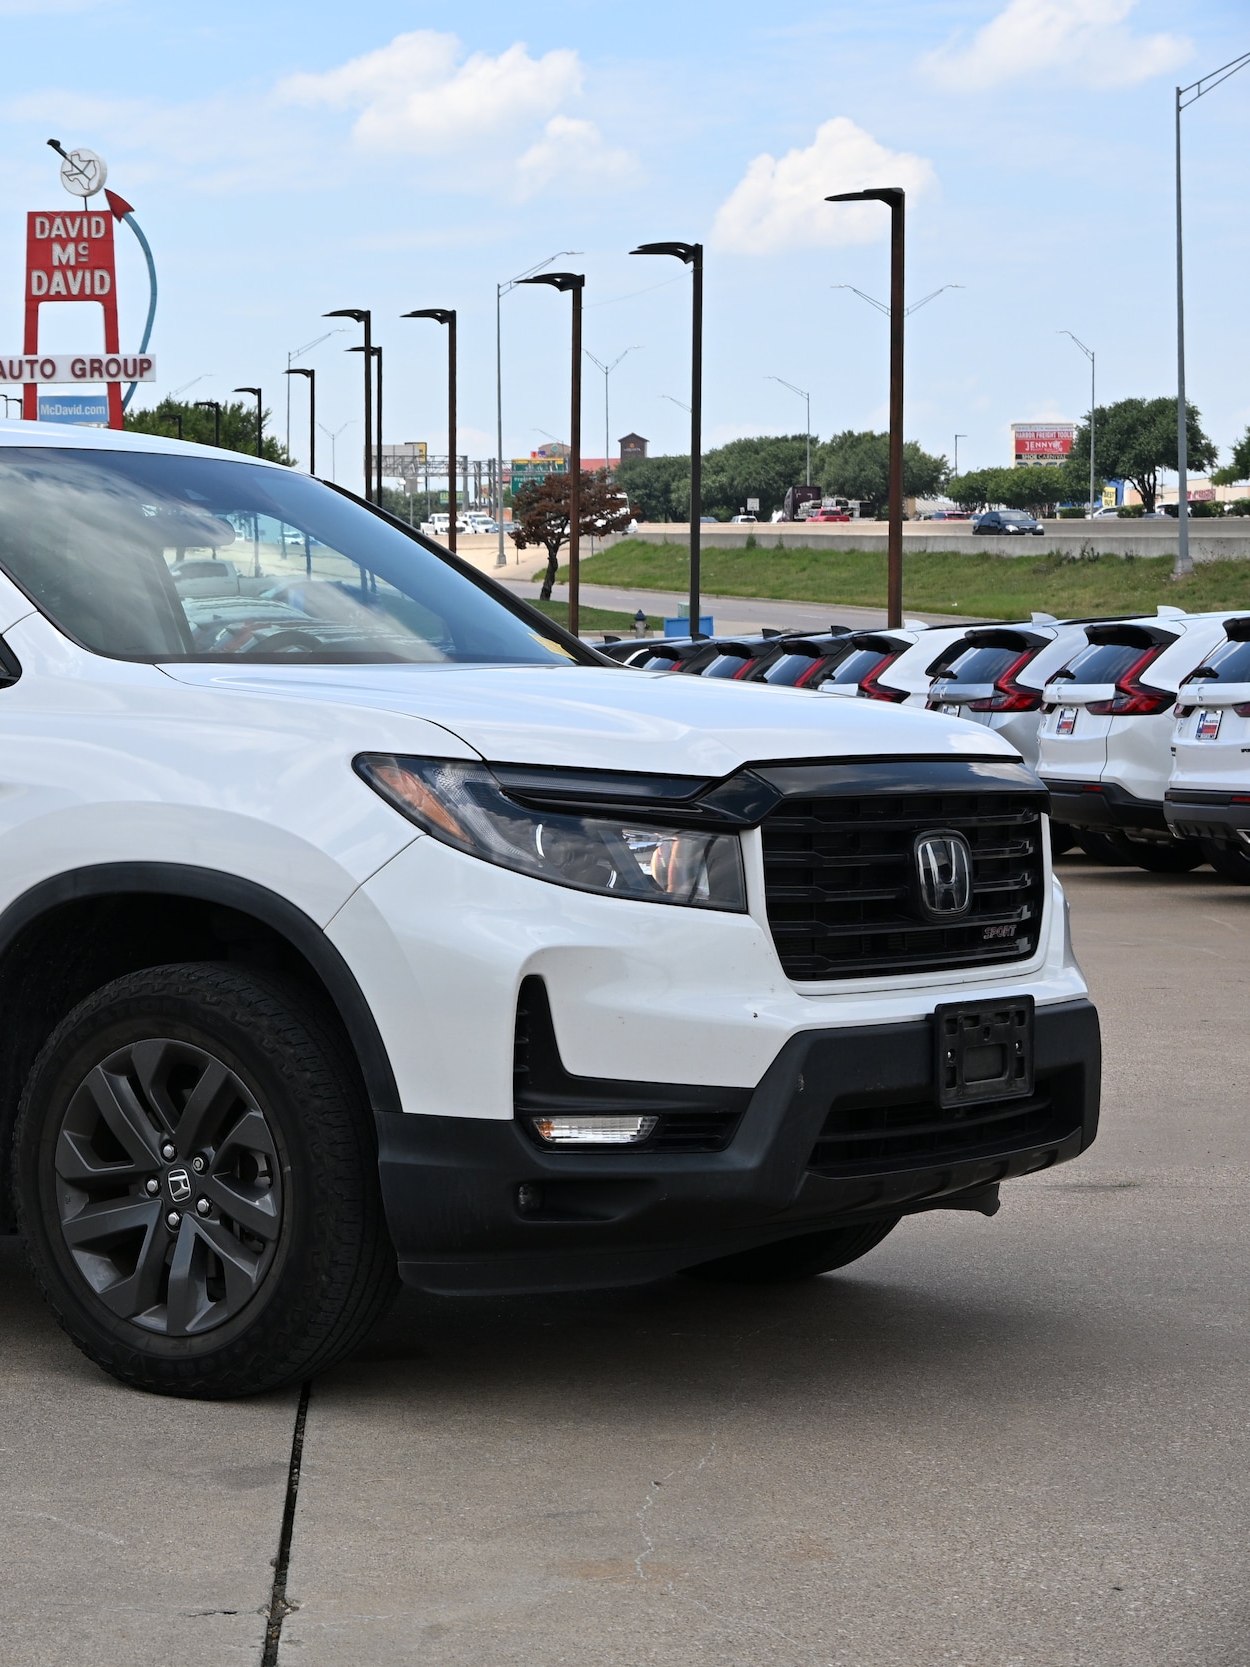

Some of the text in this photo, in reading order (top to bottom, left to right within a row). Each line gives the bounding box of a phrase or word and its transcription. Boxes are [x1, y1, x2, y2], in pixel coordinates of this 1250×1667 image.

[35, 216, 105, 239] DAVID
[31, 269, 111, 296] DAVID
[70, 358, 152, 379] GROUP
[40, 404, 106, 415] McDavid.com
[1025, 441, 1053, 451] JENNY
[983, 924, 1017, 939] SPORT
